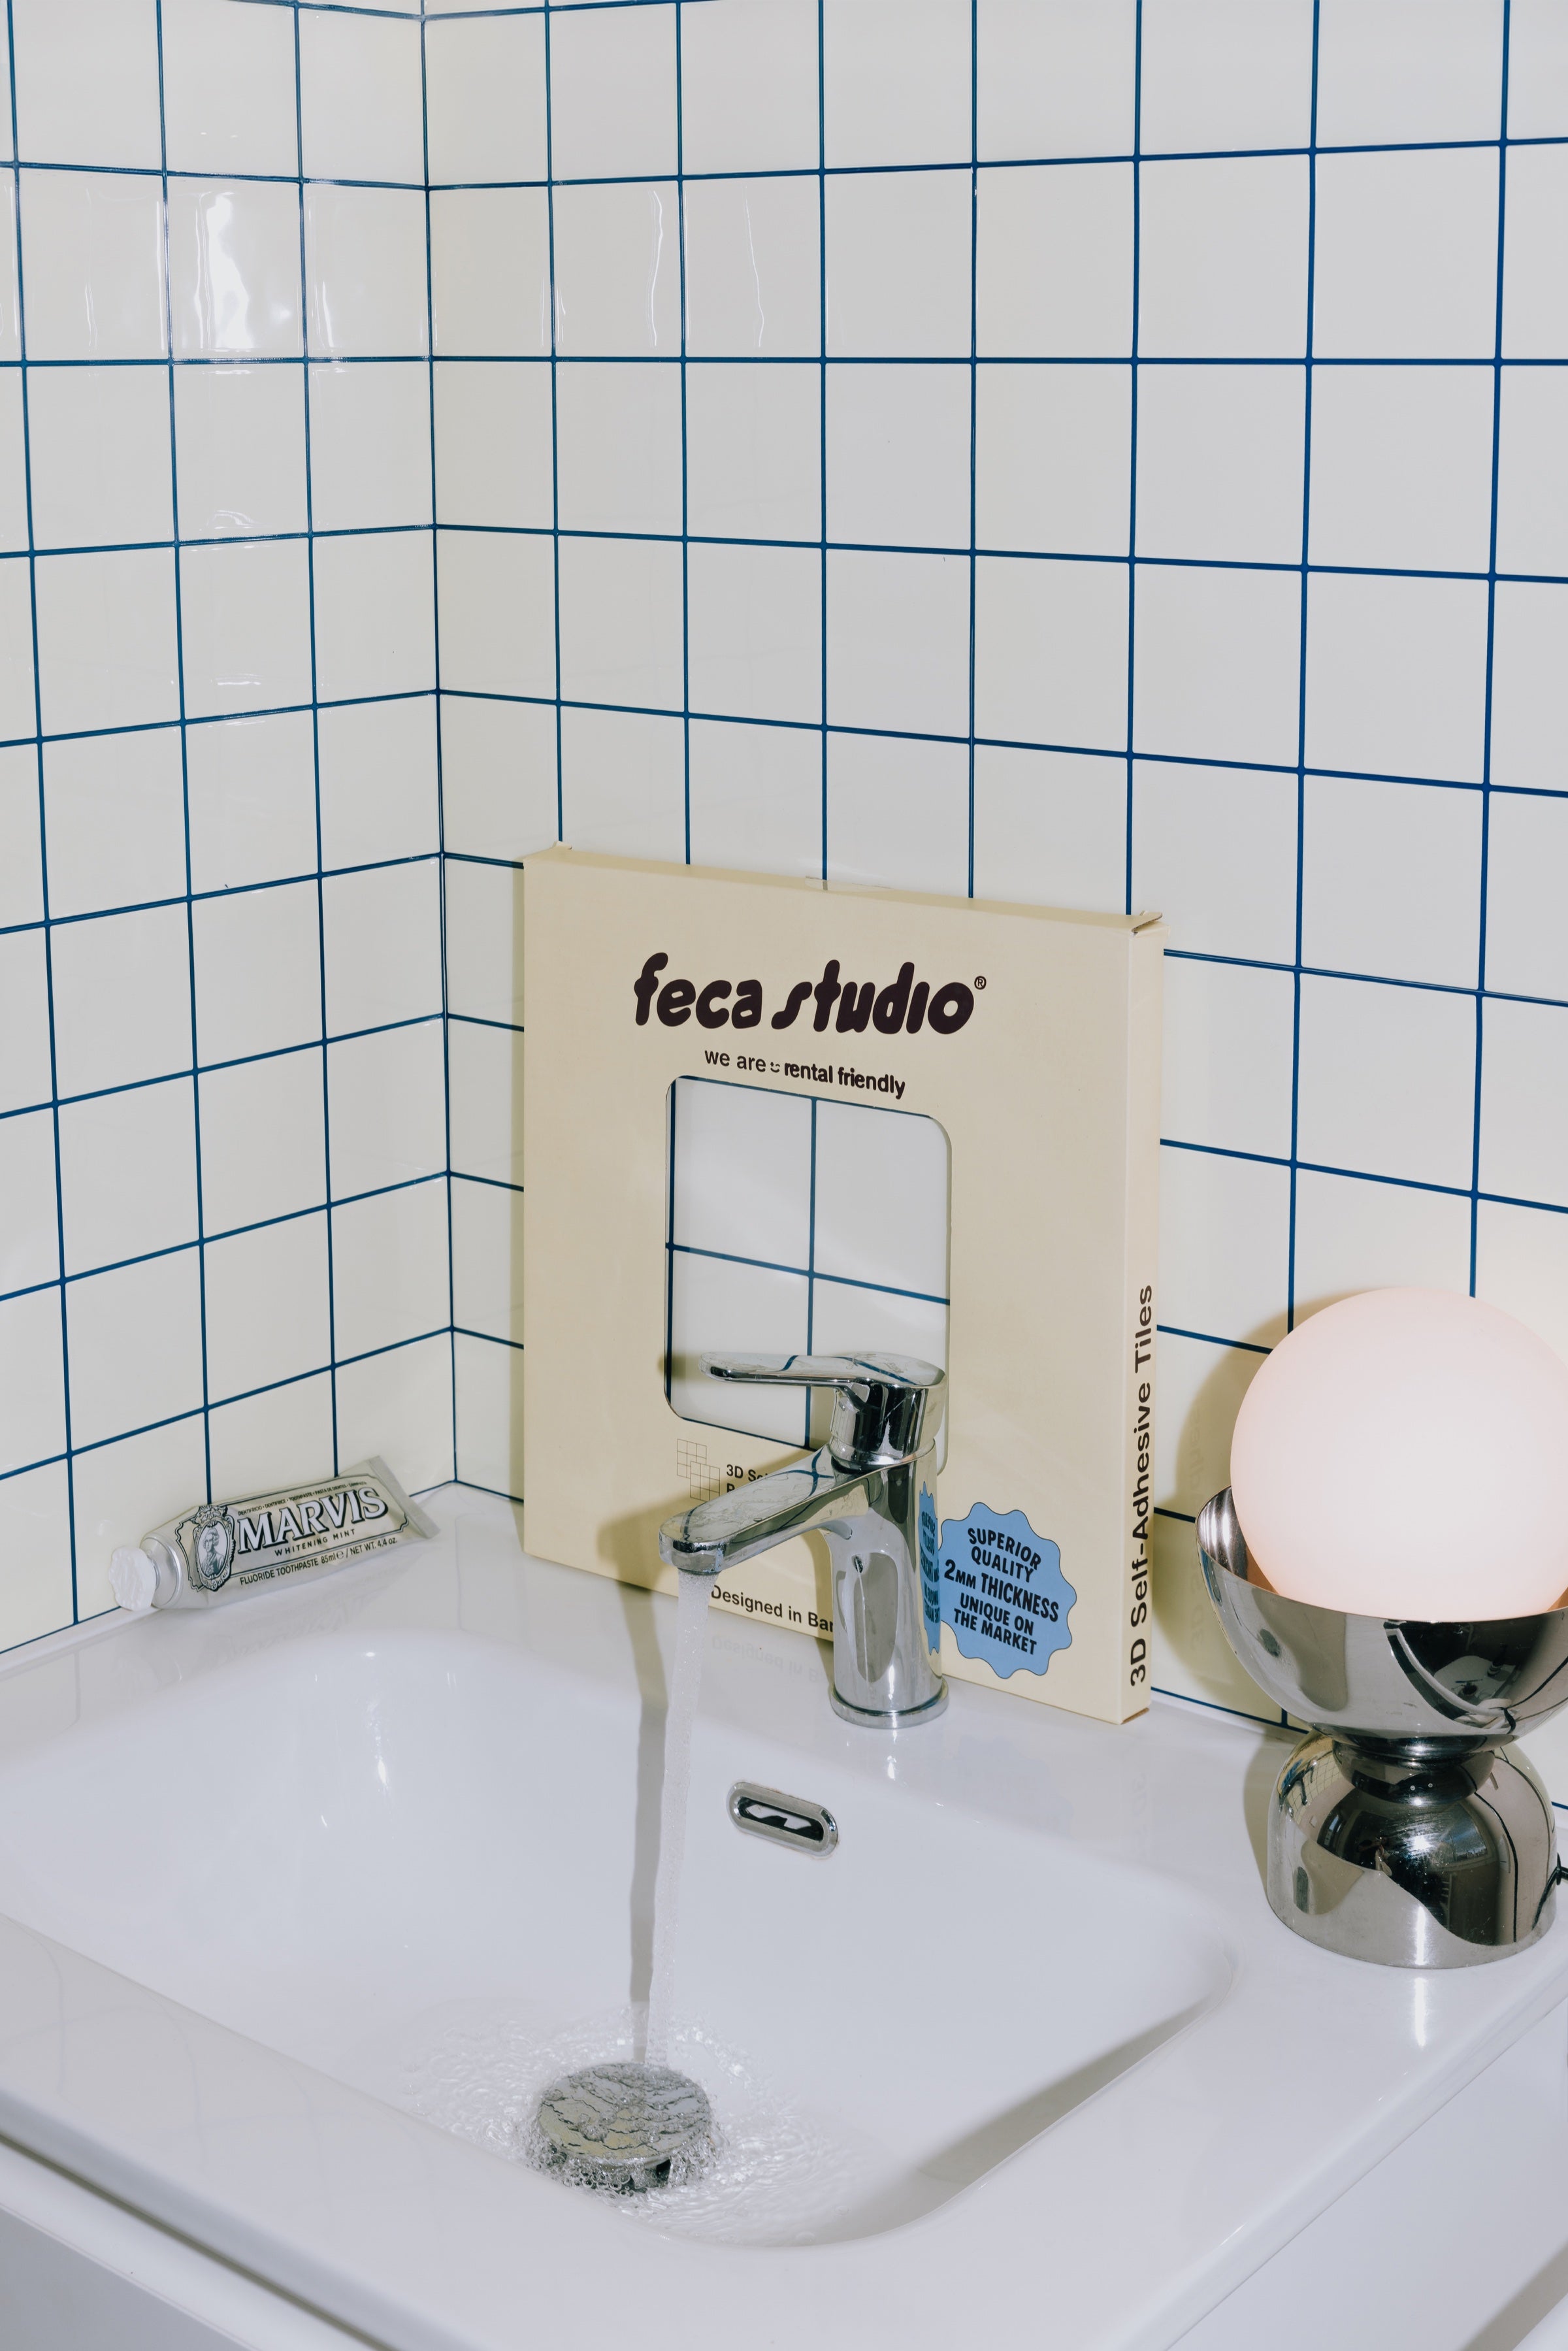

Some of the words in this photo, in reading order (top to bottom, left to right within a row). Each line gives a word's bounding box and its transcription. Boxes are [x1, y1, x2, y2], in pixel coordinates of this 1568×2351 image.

[634, 952, 762, 1029] feca
[704, 1050, 730, 1066] we
[736, 1055, 766, 1072] are
[784, 1062, 833, 1083] rental
[838, 1066, 906, 1100] friendly
[1135, 1285, 1152, 1373] Tiles
[726, 1464, 743, 1479] 3D
[237, 1487, 388, 1554] MARVIS
[1130, 1382, 1151, 1628] Self-Adhesive
[240, 1569, 276, 1586] FLUORIDE
[276, 1558, 319, 1577] TOOTHPASTE
[350, 1544, 364, 1556] NET
[363, 1541, 377, 1552] WT.
[275, 1537, 328, 1556] WHITENING
[333, 1528, 355, 1540] MINT
[967, 1527, 1041, 1570] SUPERIOR
[971, 1545, 1034, 1583] QUALITY
[711, 1585, 783, 1618] Designed
[788, 1605, 802, 1623] in
[944, 1559, 976, 1589] 2MM
[981, 1572, 1059, 1622] THICKNESS
[960, 1592, 1011, 1626] UNIQUE
[1014, 1615, 1034, 1636] ON
[954, 1608, 977, 1631] THE
[981, 1622, 1037, 1655] MARKET
[1130, 1638, 1147, 1686] 3D
